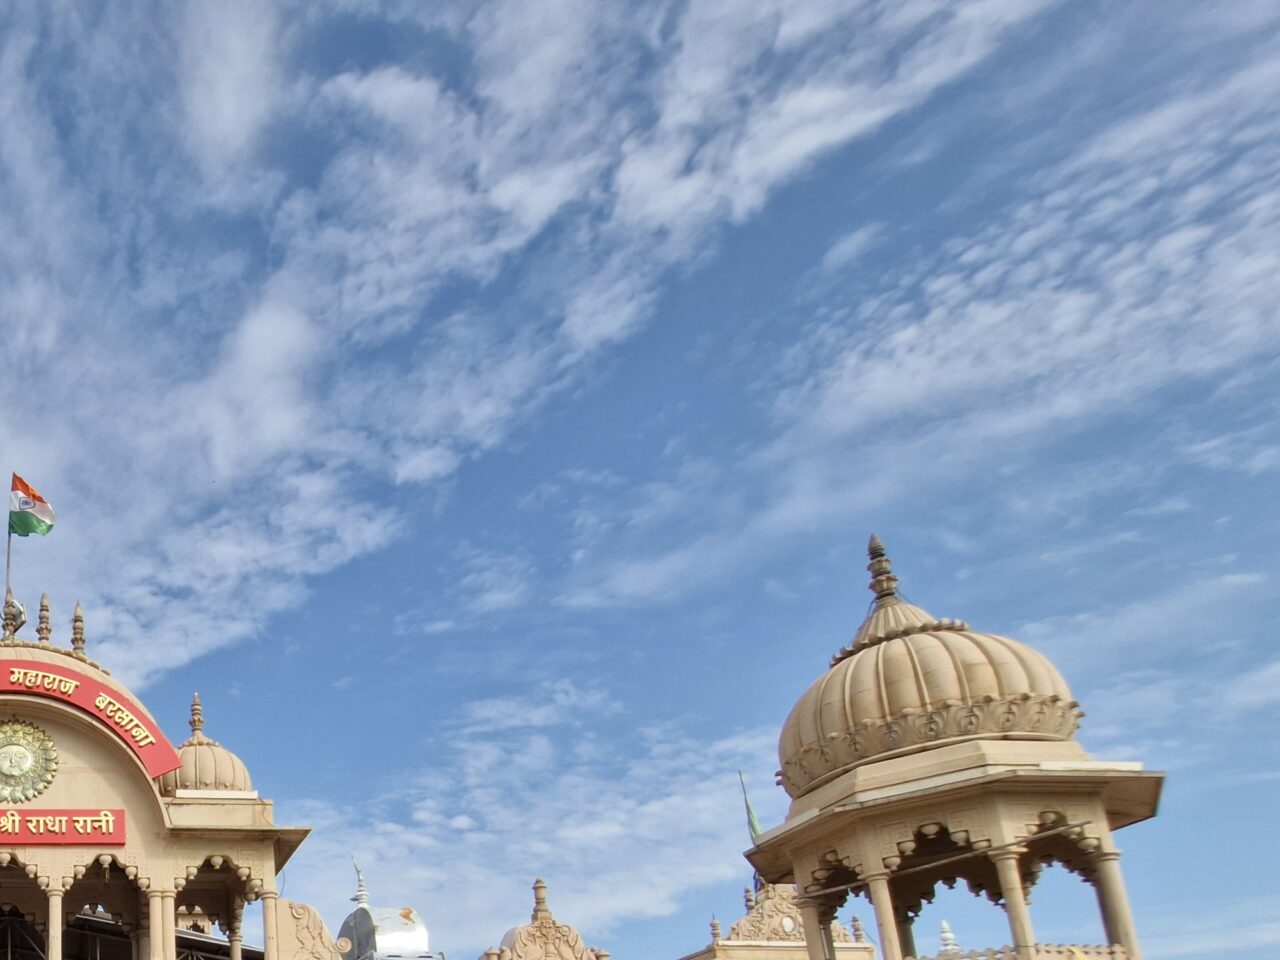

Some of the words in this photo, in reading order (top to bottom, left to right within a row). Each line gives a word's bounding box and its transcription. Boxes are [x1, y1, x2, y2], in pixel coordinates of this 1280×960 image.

[9, 667, 80, 695] महाराज
[94, 692, 156, 747] बरसाना
[25, 815, 68, 834] राधा
[72, 811, 115, 834] रानी
